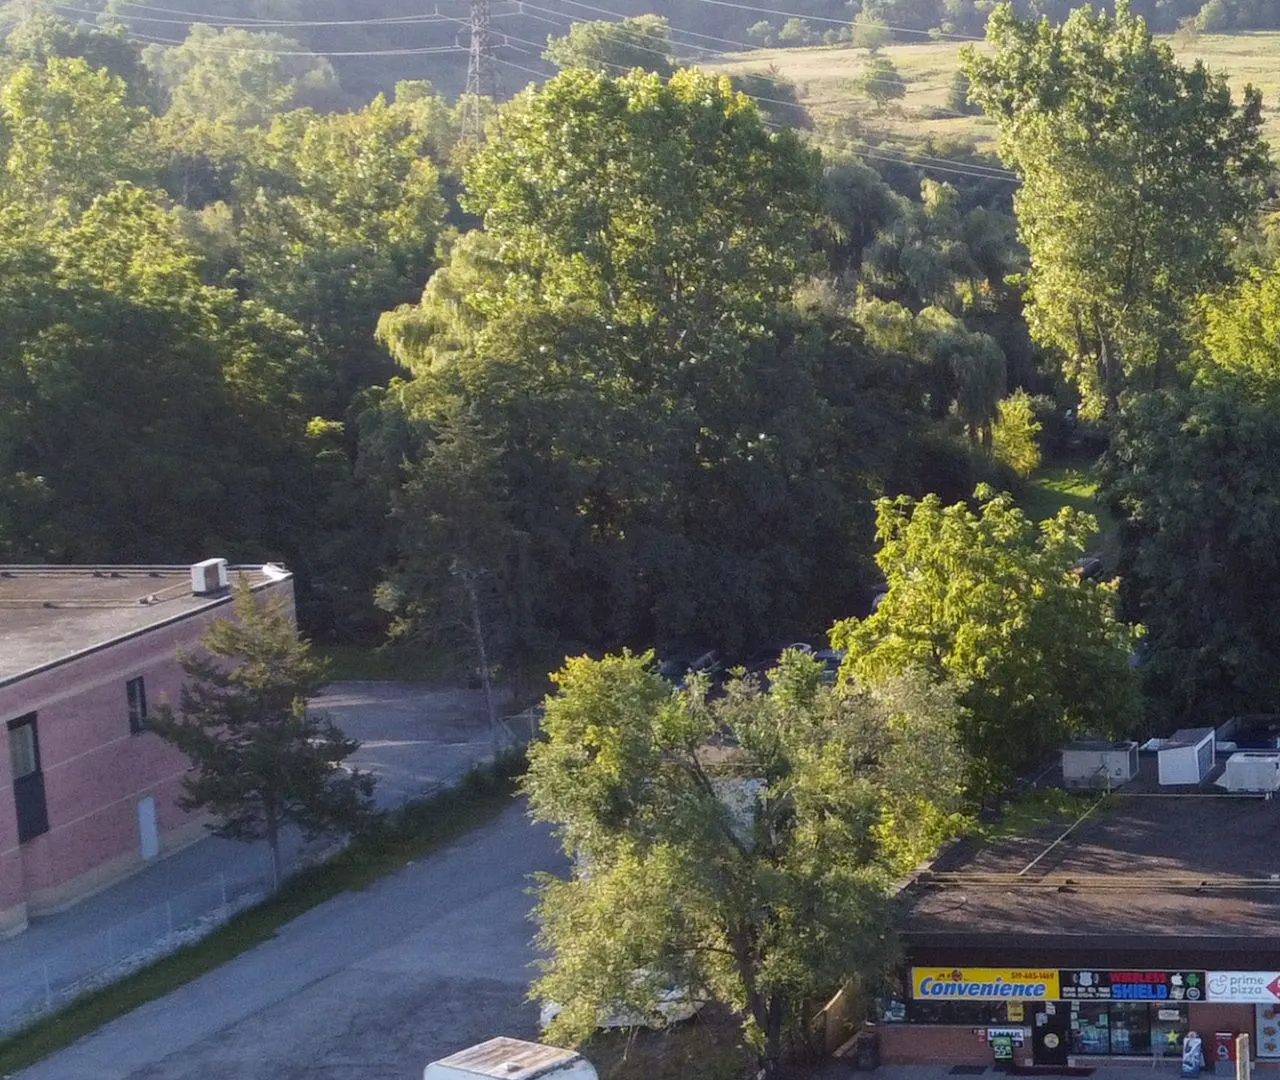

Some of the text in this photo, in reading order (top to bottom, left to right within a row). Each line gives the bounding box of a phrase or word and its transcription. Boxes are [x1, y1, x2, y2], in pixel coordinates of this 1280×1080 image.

[920, 977, 1046, 997] Convenience
[1230, 975, 1265, 986] prime
[1111, 984, 1168, 999] SHIELD
[1230, 985, 1262, 996] pizza
